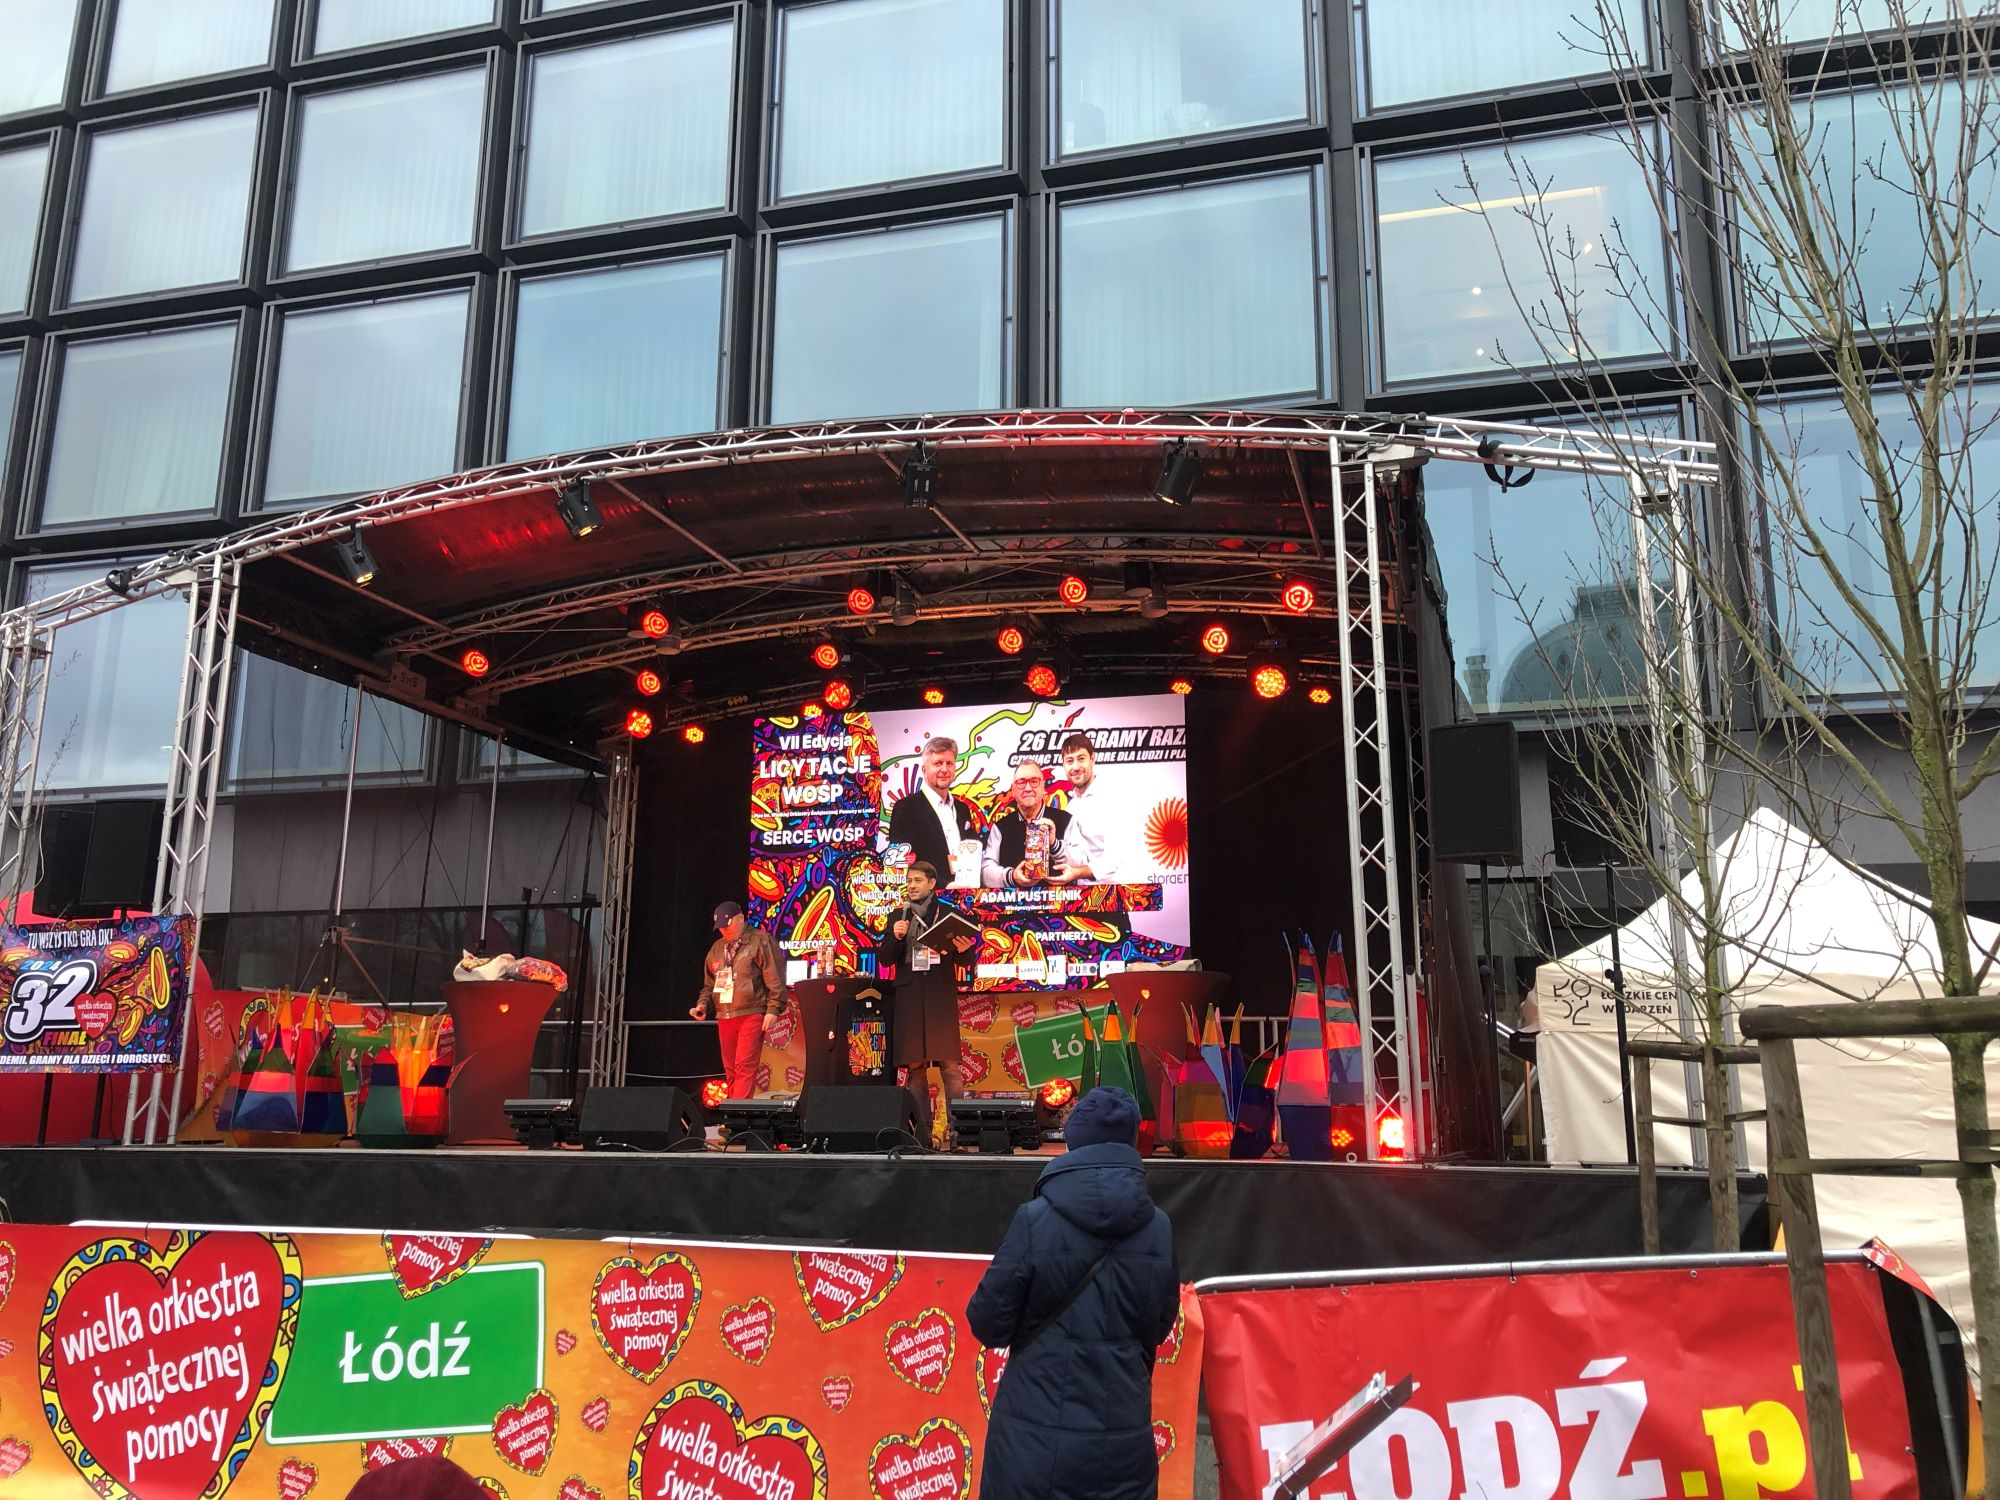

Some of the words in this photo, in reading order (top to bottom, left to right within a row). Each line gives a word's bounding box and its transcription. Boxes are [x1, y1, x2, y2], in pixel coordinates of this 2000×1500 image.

[779, 735, 800, 750] VII
[802, 733, 853, 752] Edycja
[1018, 732, 1046, 752] 26
[1047, 730, 1082, 751] LA
[1149, 728, 1186, 747] RAZ
[760, 755, 871, 779] LICYTACJE
[1116, 750, 1136, 761] DLA
[1136, 750, 1164, 761] LUDZI
[782, 779, 843, 805] WOŚP
[762, 829, 812, 846] SERCE
[816, 823, 865, 843] WOŚP
[979, 891, 1016, 903] ADAM
[1017, 889, 1083, 901] PUSTELNIK
[28, 932, 38, 949] TU
[39, 930, 79, 948] WSZYSTKO
[80, 930, 97, 946] GRA
[98, 928, 114, 946] OK!
[1035, 932, 1095, 942] PARTNERZY
[20, 960, 62, 971] 2024
[6, 961, 95, 1039] 32
[1602, 1002, 1673, 1014] WDARZEŃ
[43, 1031, 87, 1046] FINAŁ
[1052, 1034, 1084, 1061] Łó
[29, 1055, 62, 1065] GRAMY
[62, 1055, 80, 1065] DLA
[80, 1054, 110, 1064] DZIECI
[399, 1240, 445, 1281] pomocy
[600, 1280, 637, 1306] wielka
[638, 1277, 685, 1302] orkiestra
[812, 1277, 857, 1314] pomocy
[61, 1292, 145, 1366] wielka
[149, 1262, 260, 1335] orkiestra
[610, 1304, 679, 1335] świątecznej
[724, 1316, 744, 1333] wielka
[743, 1308, 768, 1325] orkiestra
[624, 1332, 669, 1358] pomocy
[732, 1322, 768, 1345] świątecznej
[741, 1337, 765, 1355] pomocy
[891, 1333, 915, 1356] wielka
[914, 1324, 945, 1346] orkiestra
[338, 1320, 472, 1384] Łódź
[902, 1340, 946, 1369] świątecznej
[92, 1325, 250, 1424] świątecznej
[915, 1359, 943, 1382] pomocy
[497, 1417, 521, 1440] wielka
[520, 1404, 550, 1426] orkiestra
[126, 1406, 229, 1483] pomocy
[507, 1420, 550, 1453] świątecznej
[519, 1440, 547, 1466] pomocy
[659, 1419, 718, 1469] wielka
[718, 1445, 796, 1500] orkiestra
[878, 1454, 913, 1486] wielka
[912, 1441, 957, 1472] orkiestra
